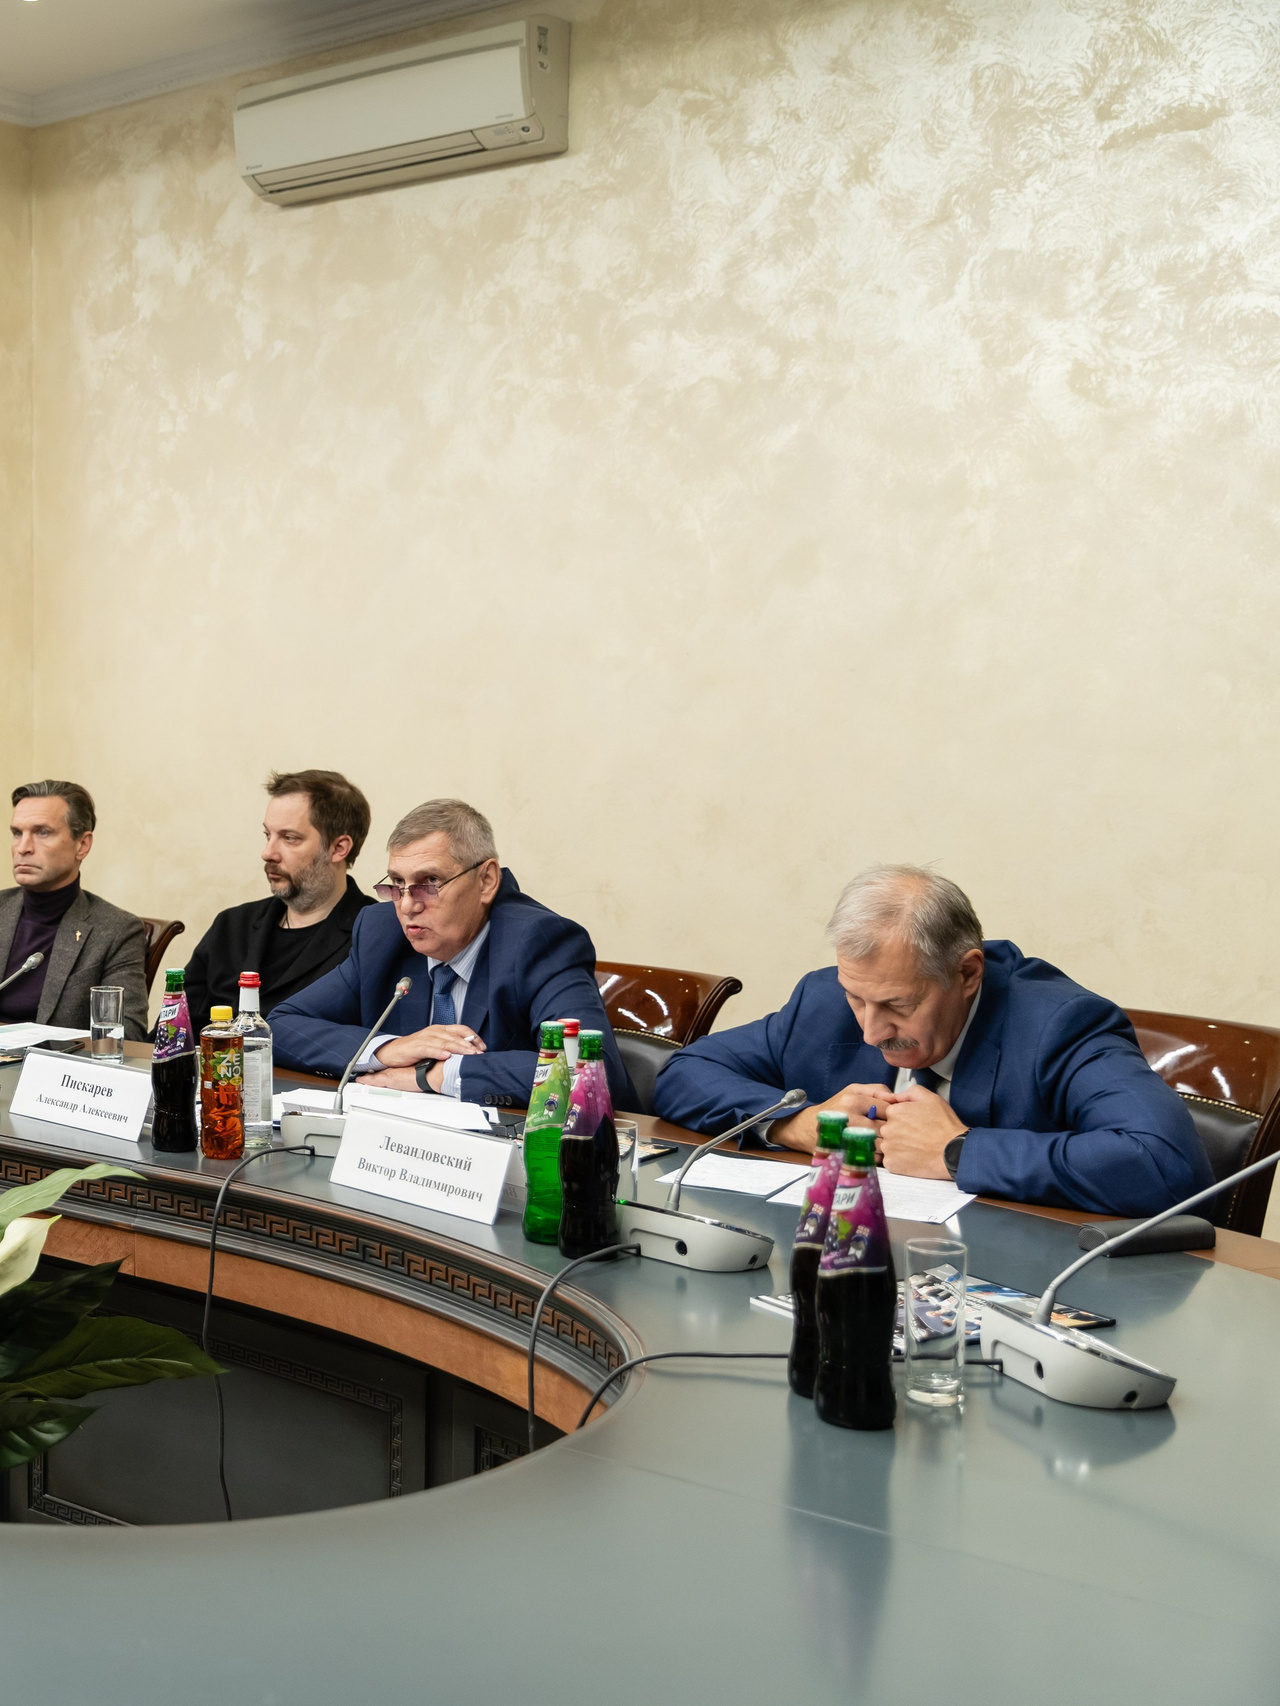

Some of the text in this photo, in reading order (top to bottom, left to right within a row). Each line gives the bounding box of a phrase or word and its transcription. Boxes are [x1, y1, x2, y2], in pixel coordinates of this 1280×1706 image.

[60, 1074, 113, 1098] Пискарев
[36, 1093, 129, 1123] Александр Алексеевич
[379, 1135, 473, 1172] Левандовский
[357, 1157, 396, 1181] Виктор
[398, 1168, 483, 1202] Владимирович
